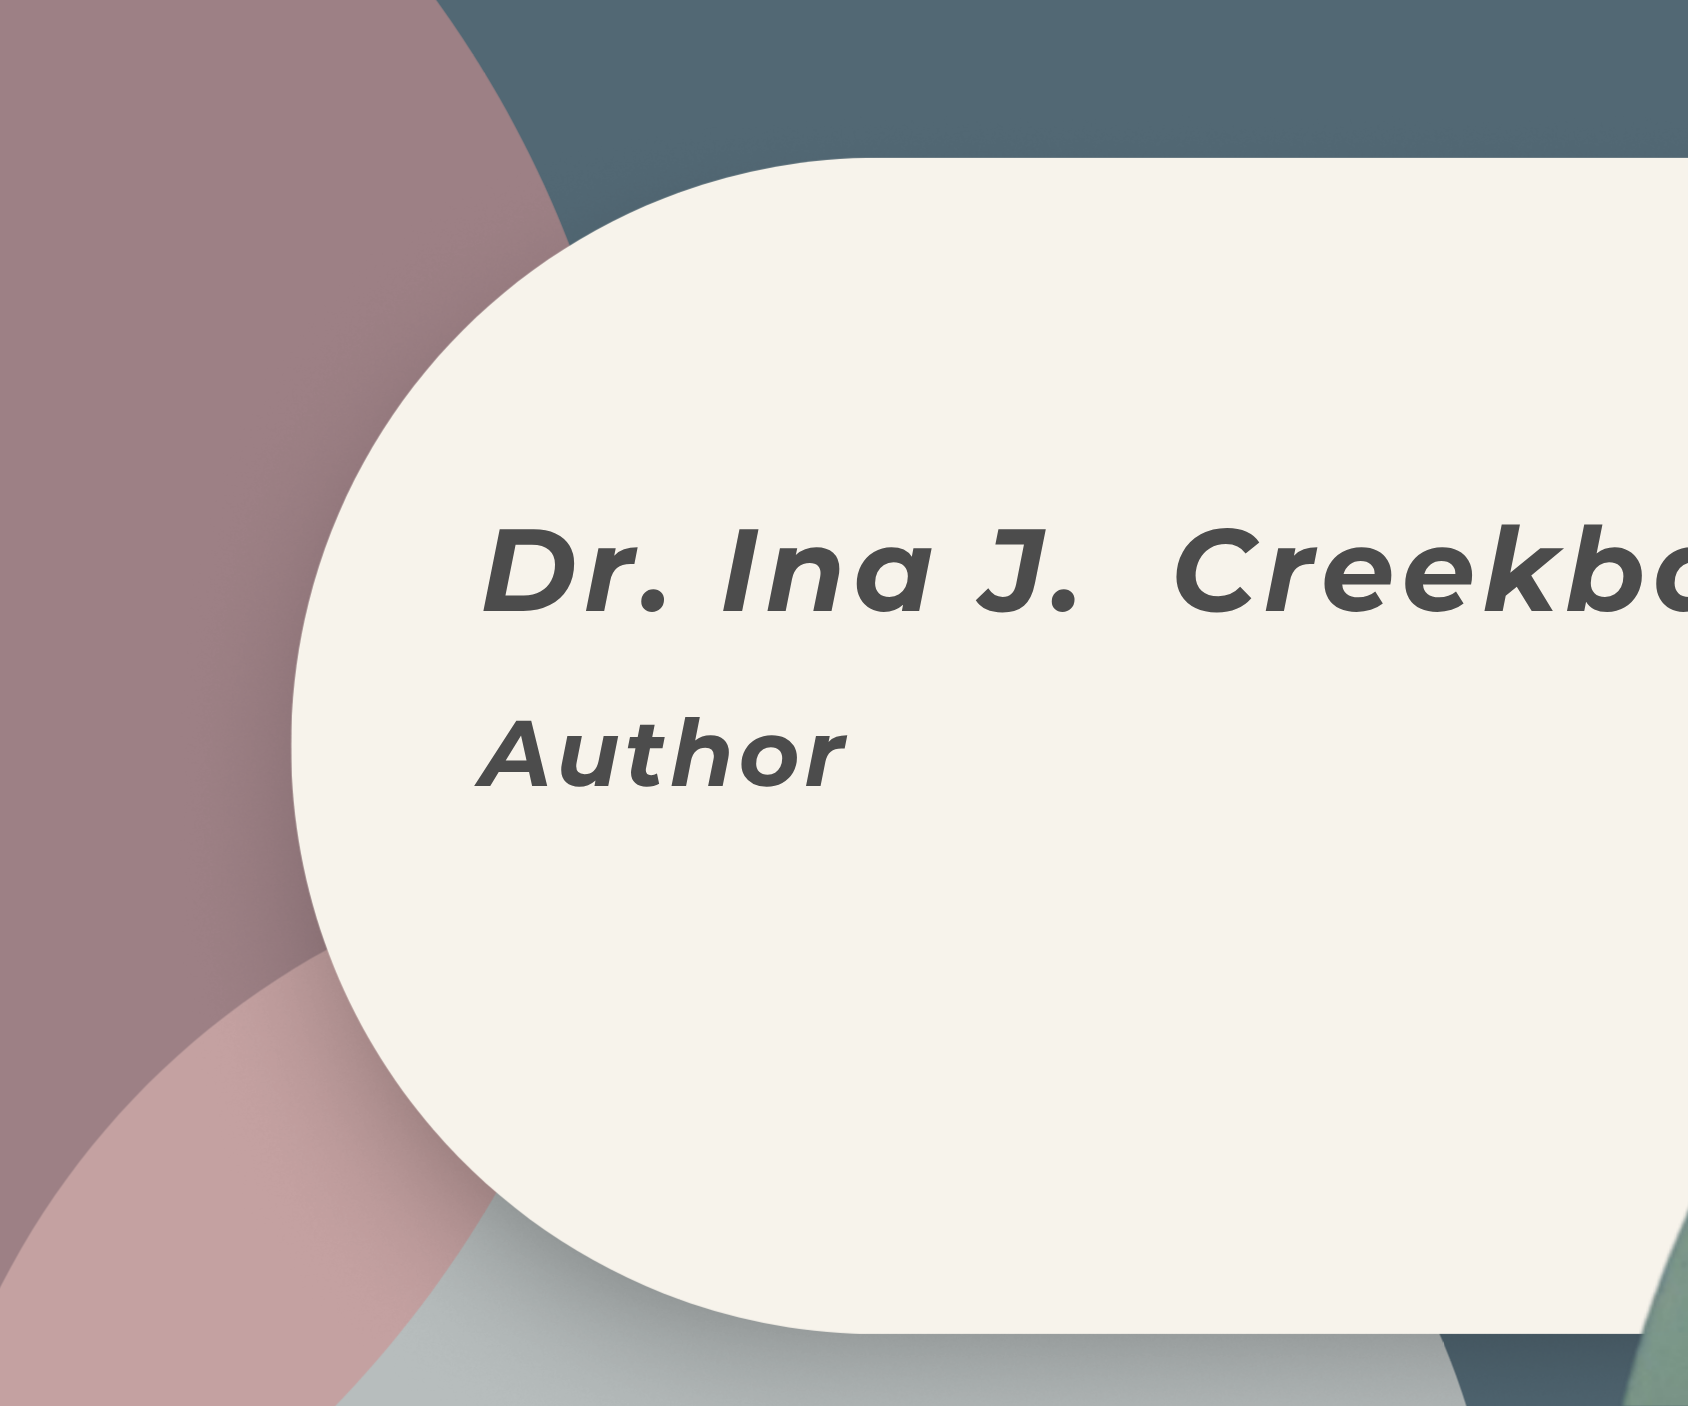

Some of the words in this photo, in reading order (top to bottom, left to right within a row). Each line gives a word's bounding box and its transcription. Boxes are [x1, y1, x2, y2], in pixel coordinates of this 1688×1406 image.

[483, 529, 664, 612] Dr.
[723, 529, 932, 612] Ina
[976, 529, 1075, 613] J.
[474, 717, 848, 787] Author
